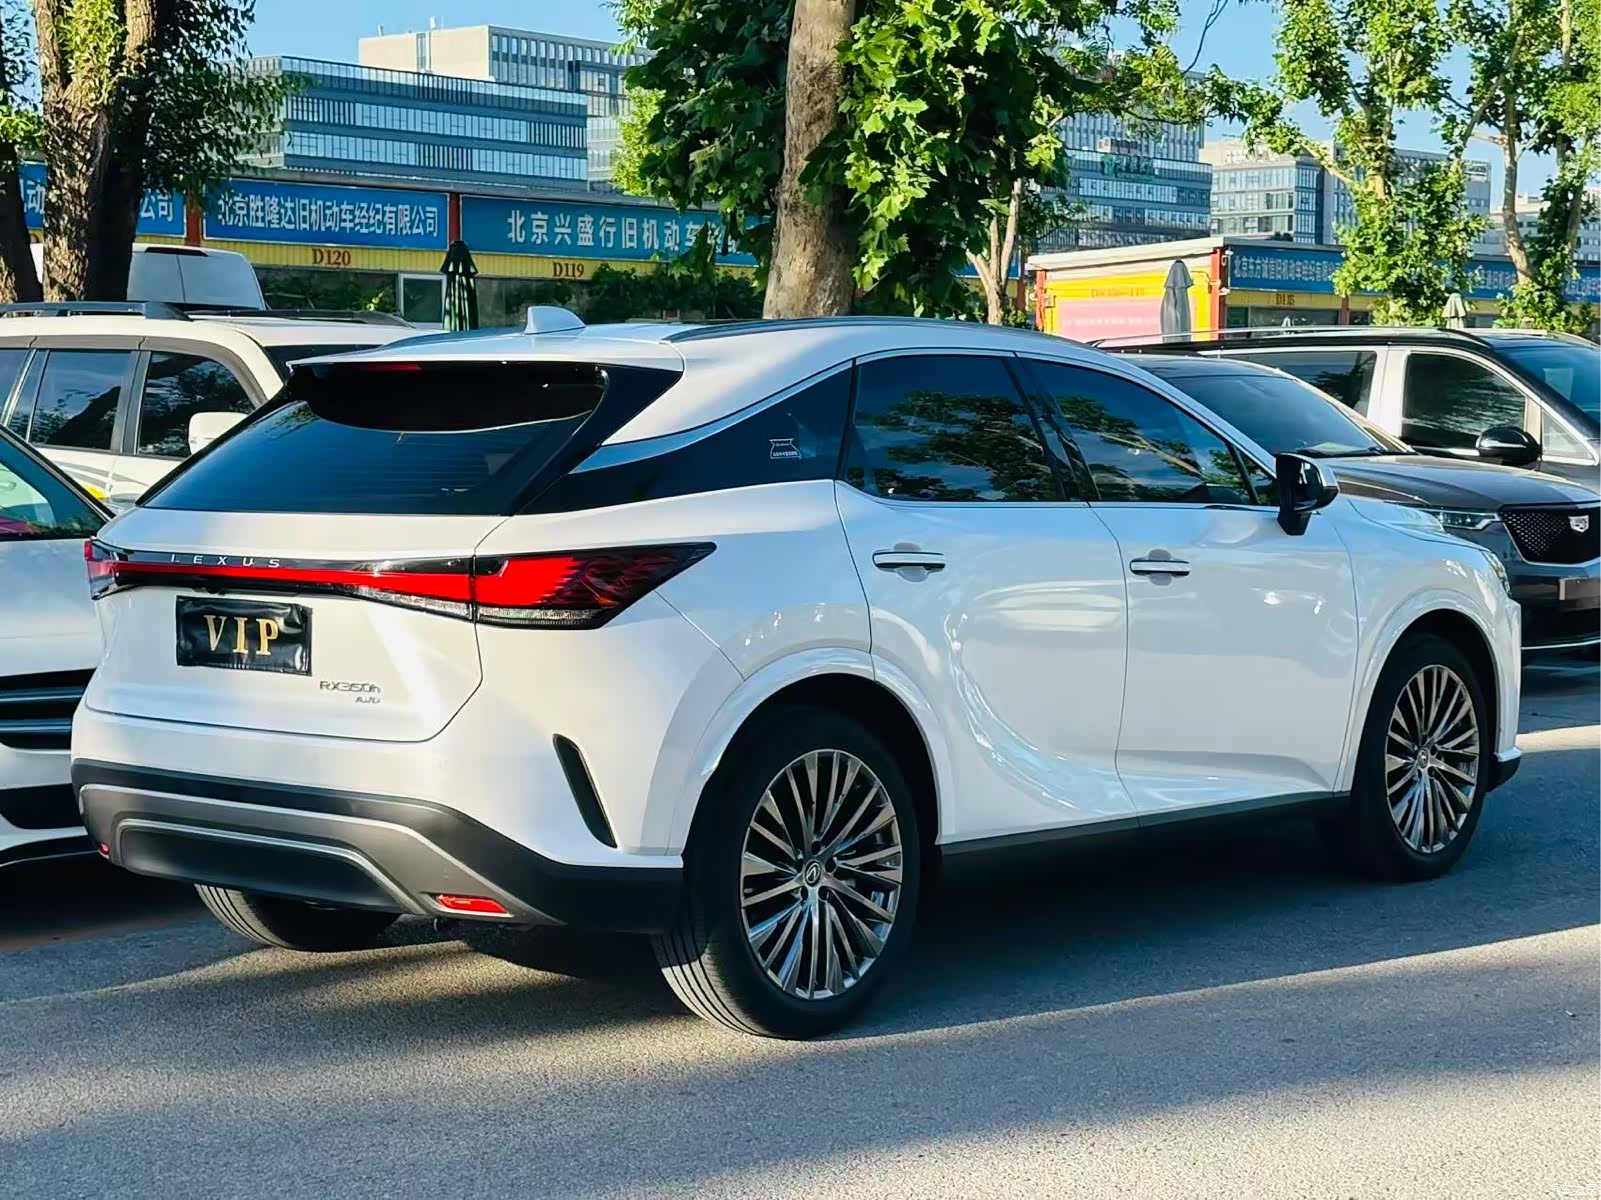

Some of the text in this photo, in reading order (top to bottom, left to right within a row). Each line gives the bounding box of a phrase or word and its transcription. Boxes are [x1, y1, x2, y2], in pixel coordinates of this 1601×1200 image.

[217, 192, 438, 238] 北京胜隆达旧机动车经纪有限公司
[312, 248, 351, 266] D120
[552, 261, 585, 278] D119
[170, 553, 281, 569] LEXUS
[203, 613, 280, 656] VIP
